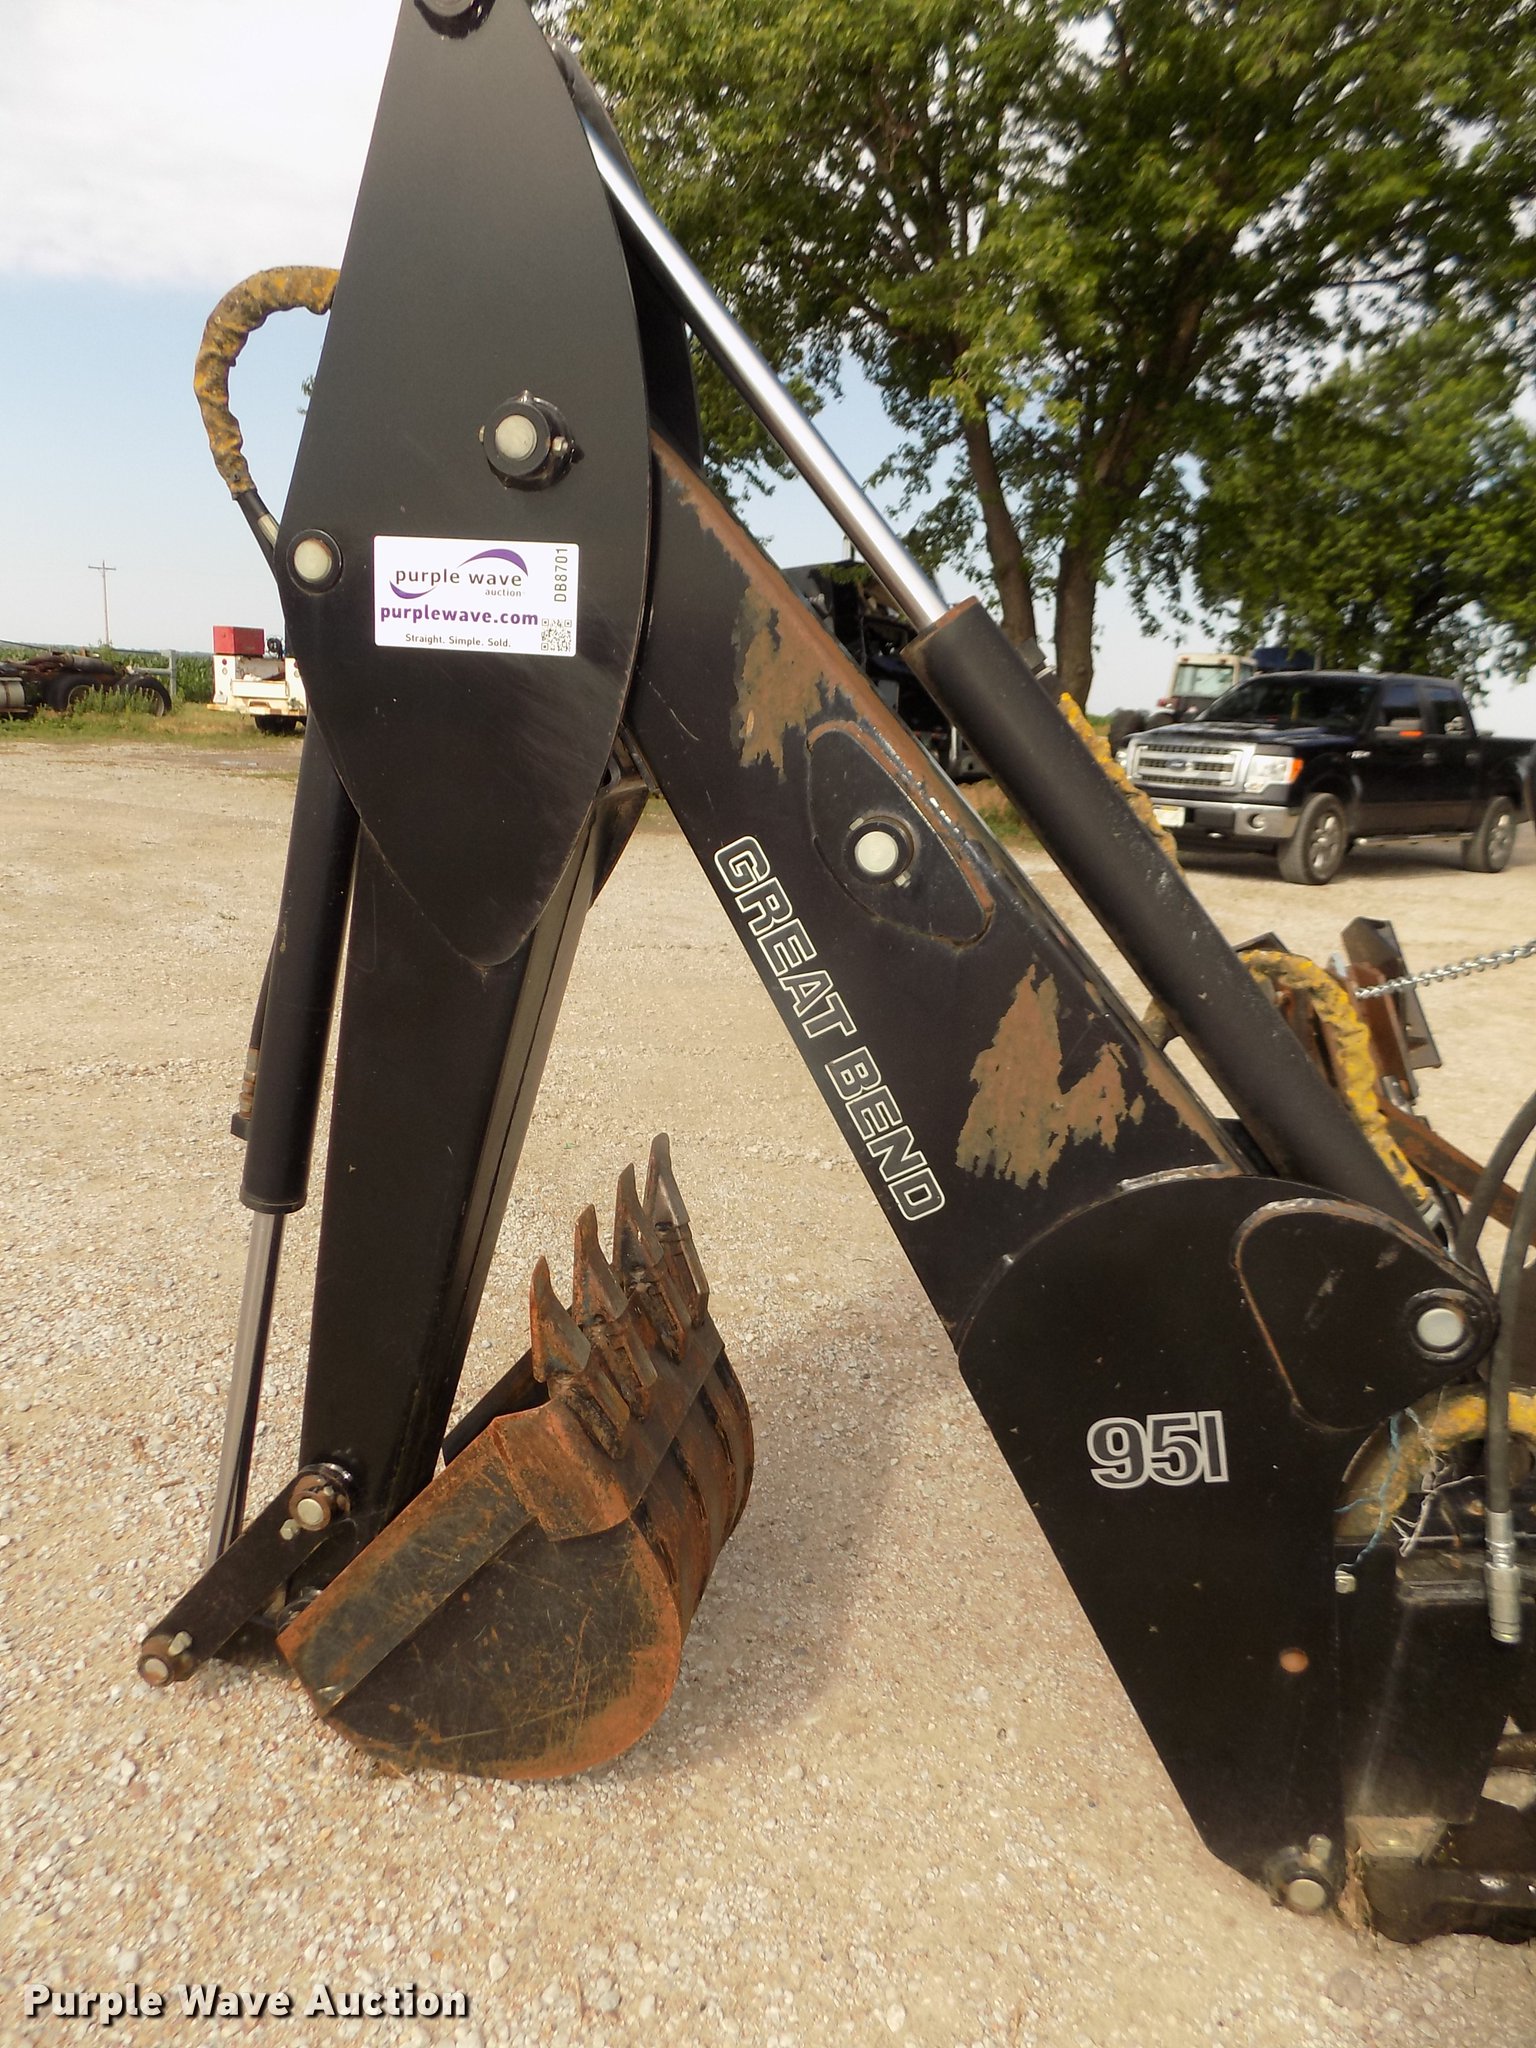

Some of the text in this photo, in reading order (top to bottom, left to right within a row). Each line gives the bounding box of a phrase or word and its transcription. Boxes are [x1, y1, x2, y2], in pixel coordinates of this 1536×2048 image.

[396, 568, 522, 587] purple wave
[554, 548, 568, 602] DB8701
[485, 588, 522, 597] auction
[380, 604, 538, 625] purplewave.com
[405, 634, 511, 648] Straight. Simple. Sold.
[714, 836, 945, 1221] GREAT BEND
